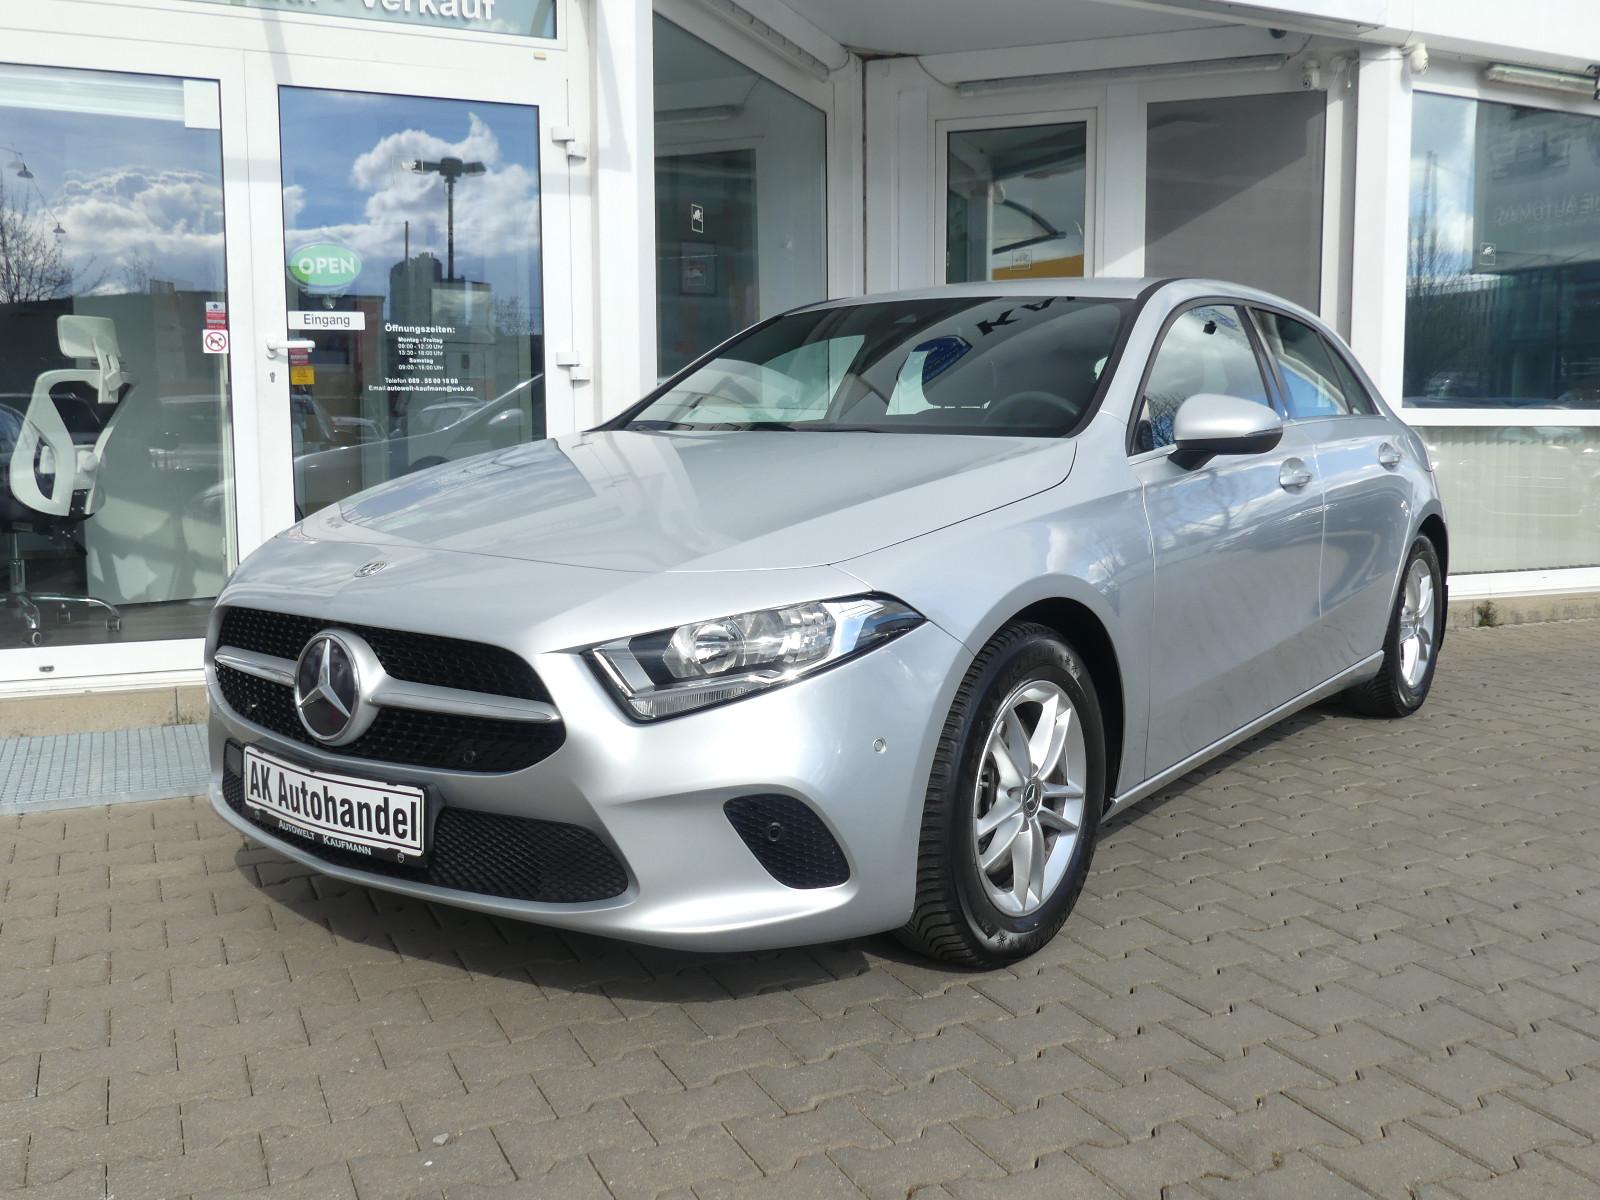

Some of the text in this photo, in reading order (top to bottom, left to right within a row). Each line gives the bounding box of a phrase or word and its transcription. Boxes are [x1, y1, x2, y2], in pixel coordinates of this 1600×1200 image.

[298, 256, 356, 275] OPEN
[303, 313, 350, 328] Eingang
[385, 323, 455, 334] Öffnungszeiten:
[250, 761, 417, 842] AK Autohandel
[322, 835, 372, 856] KAUFMANN
